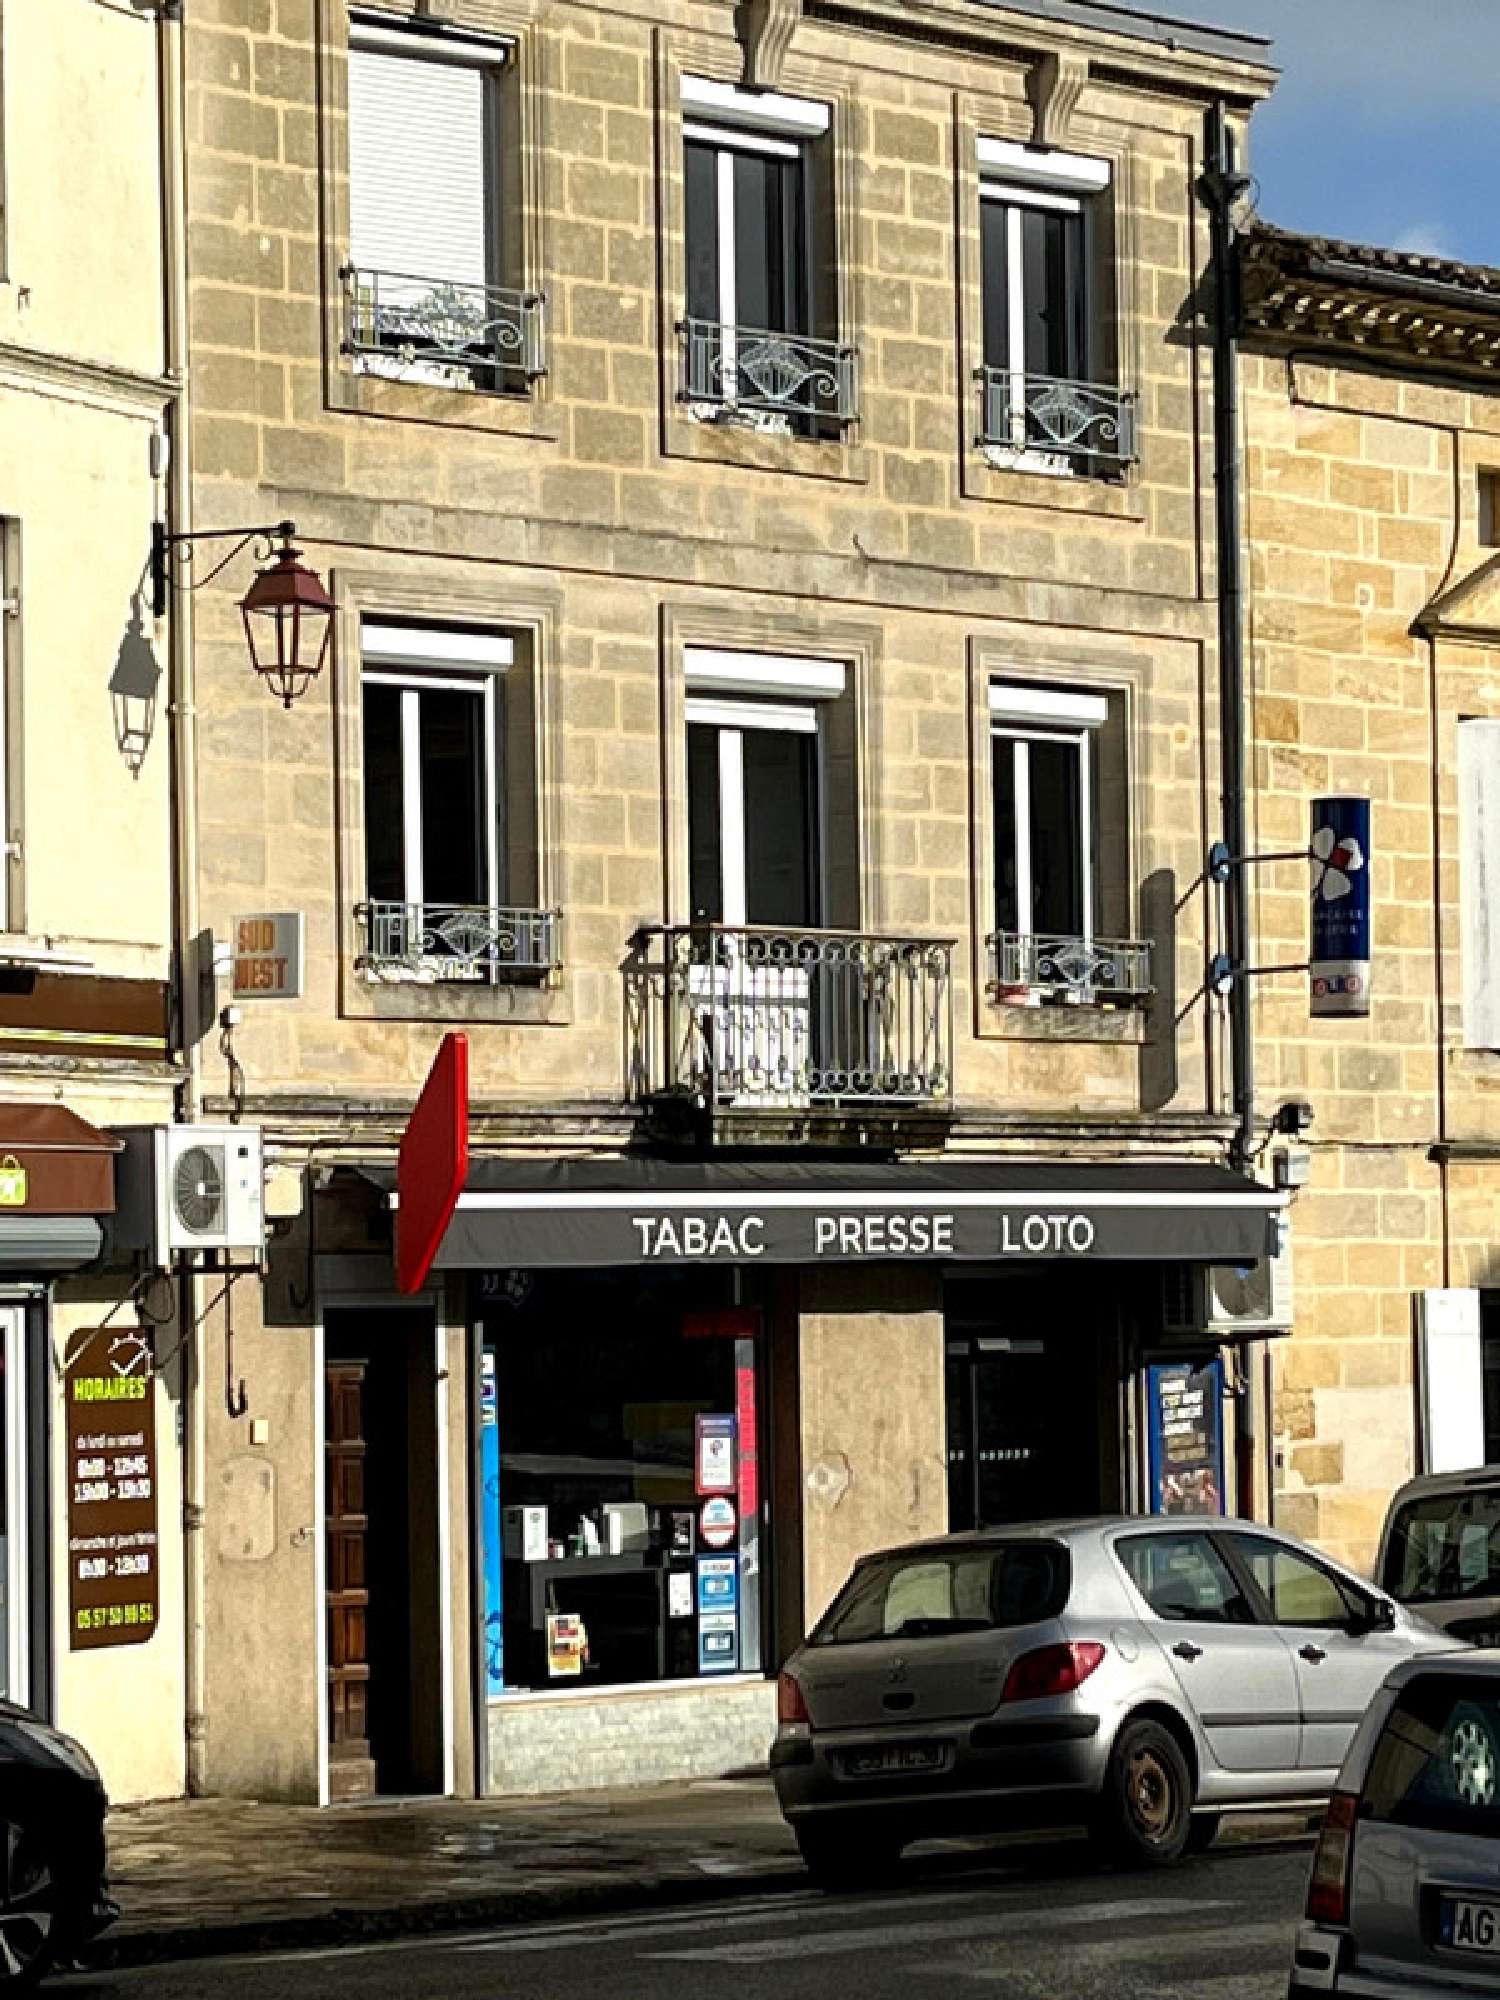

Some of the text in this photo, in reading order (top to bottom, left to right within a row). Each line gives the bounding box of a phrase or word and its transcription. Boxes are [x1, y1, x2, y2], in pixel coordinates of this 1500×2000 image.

[239, 919, 275, 952] SUD
[632, 1214, 1095, 1257] TABAC PRESSE LOTO
[1457, 1906, 1496, 1946] AG
